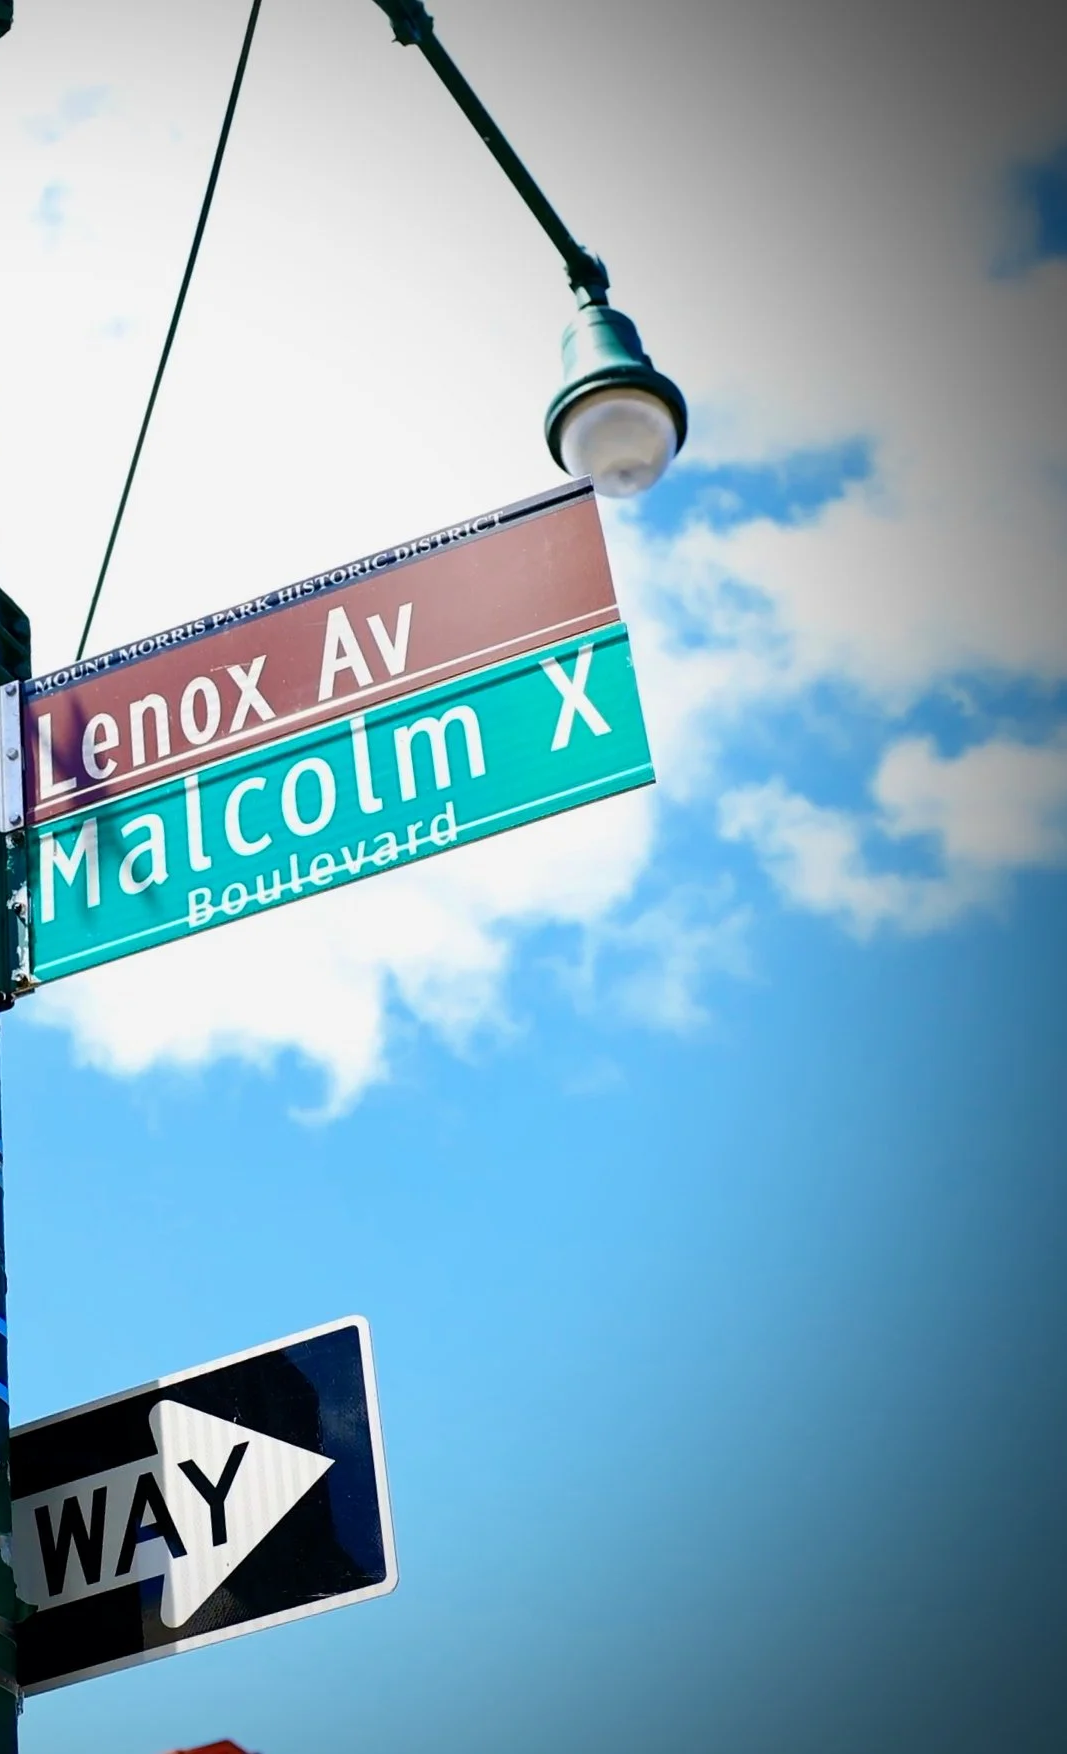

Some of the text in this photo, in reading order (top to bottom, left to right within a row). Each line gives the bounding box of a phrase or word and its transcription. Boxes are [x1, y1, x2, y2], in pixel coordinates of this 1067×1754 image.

[34, 510, 504, 695] MOUNT MORRIS PARK HISTORIC DISTRICT
[37, 601, 413, 801] Lenox Av
[38, 642, 612, 924] Malcolm X
[187, 801, 459, 928] Boulevard
[34, 1440, 250, 1598] WAY
